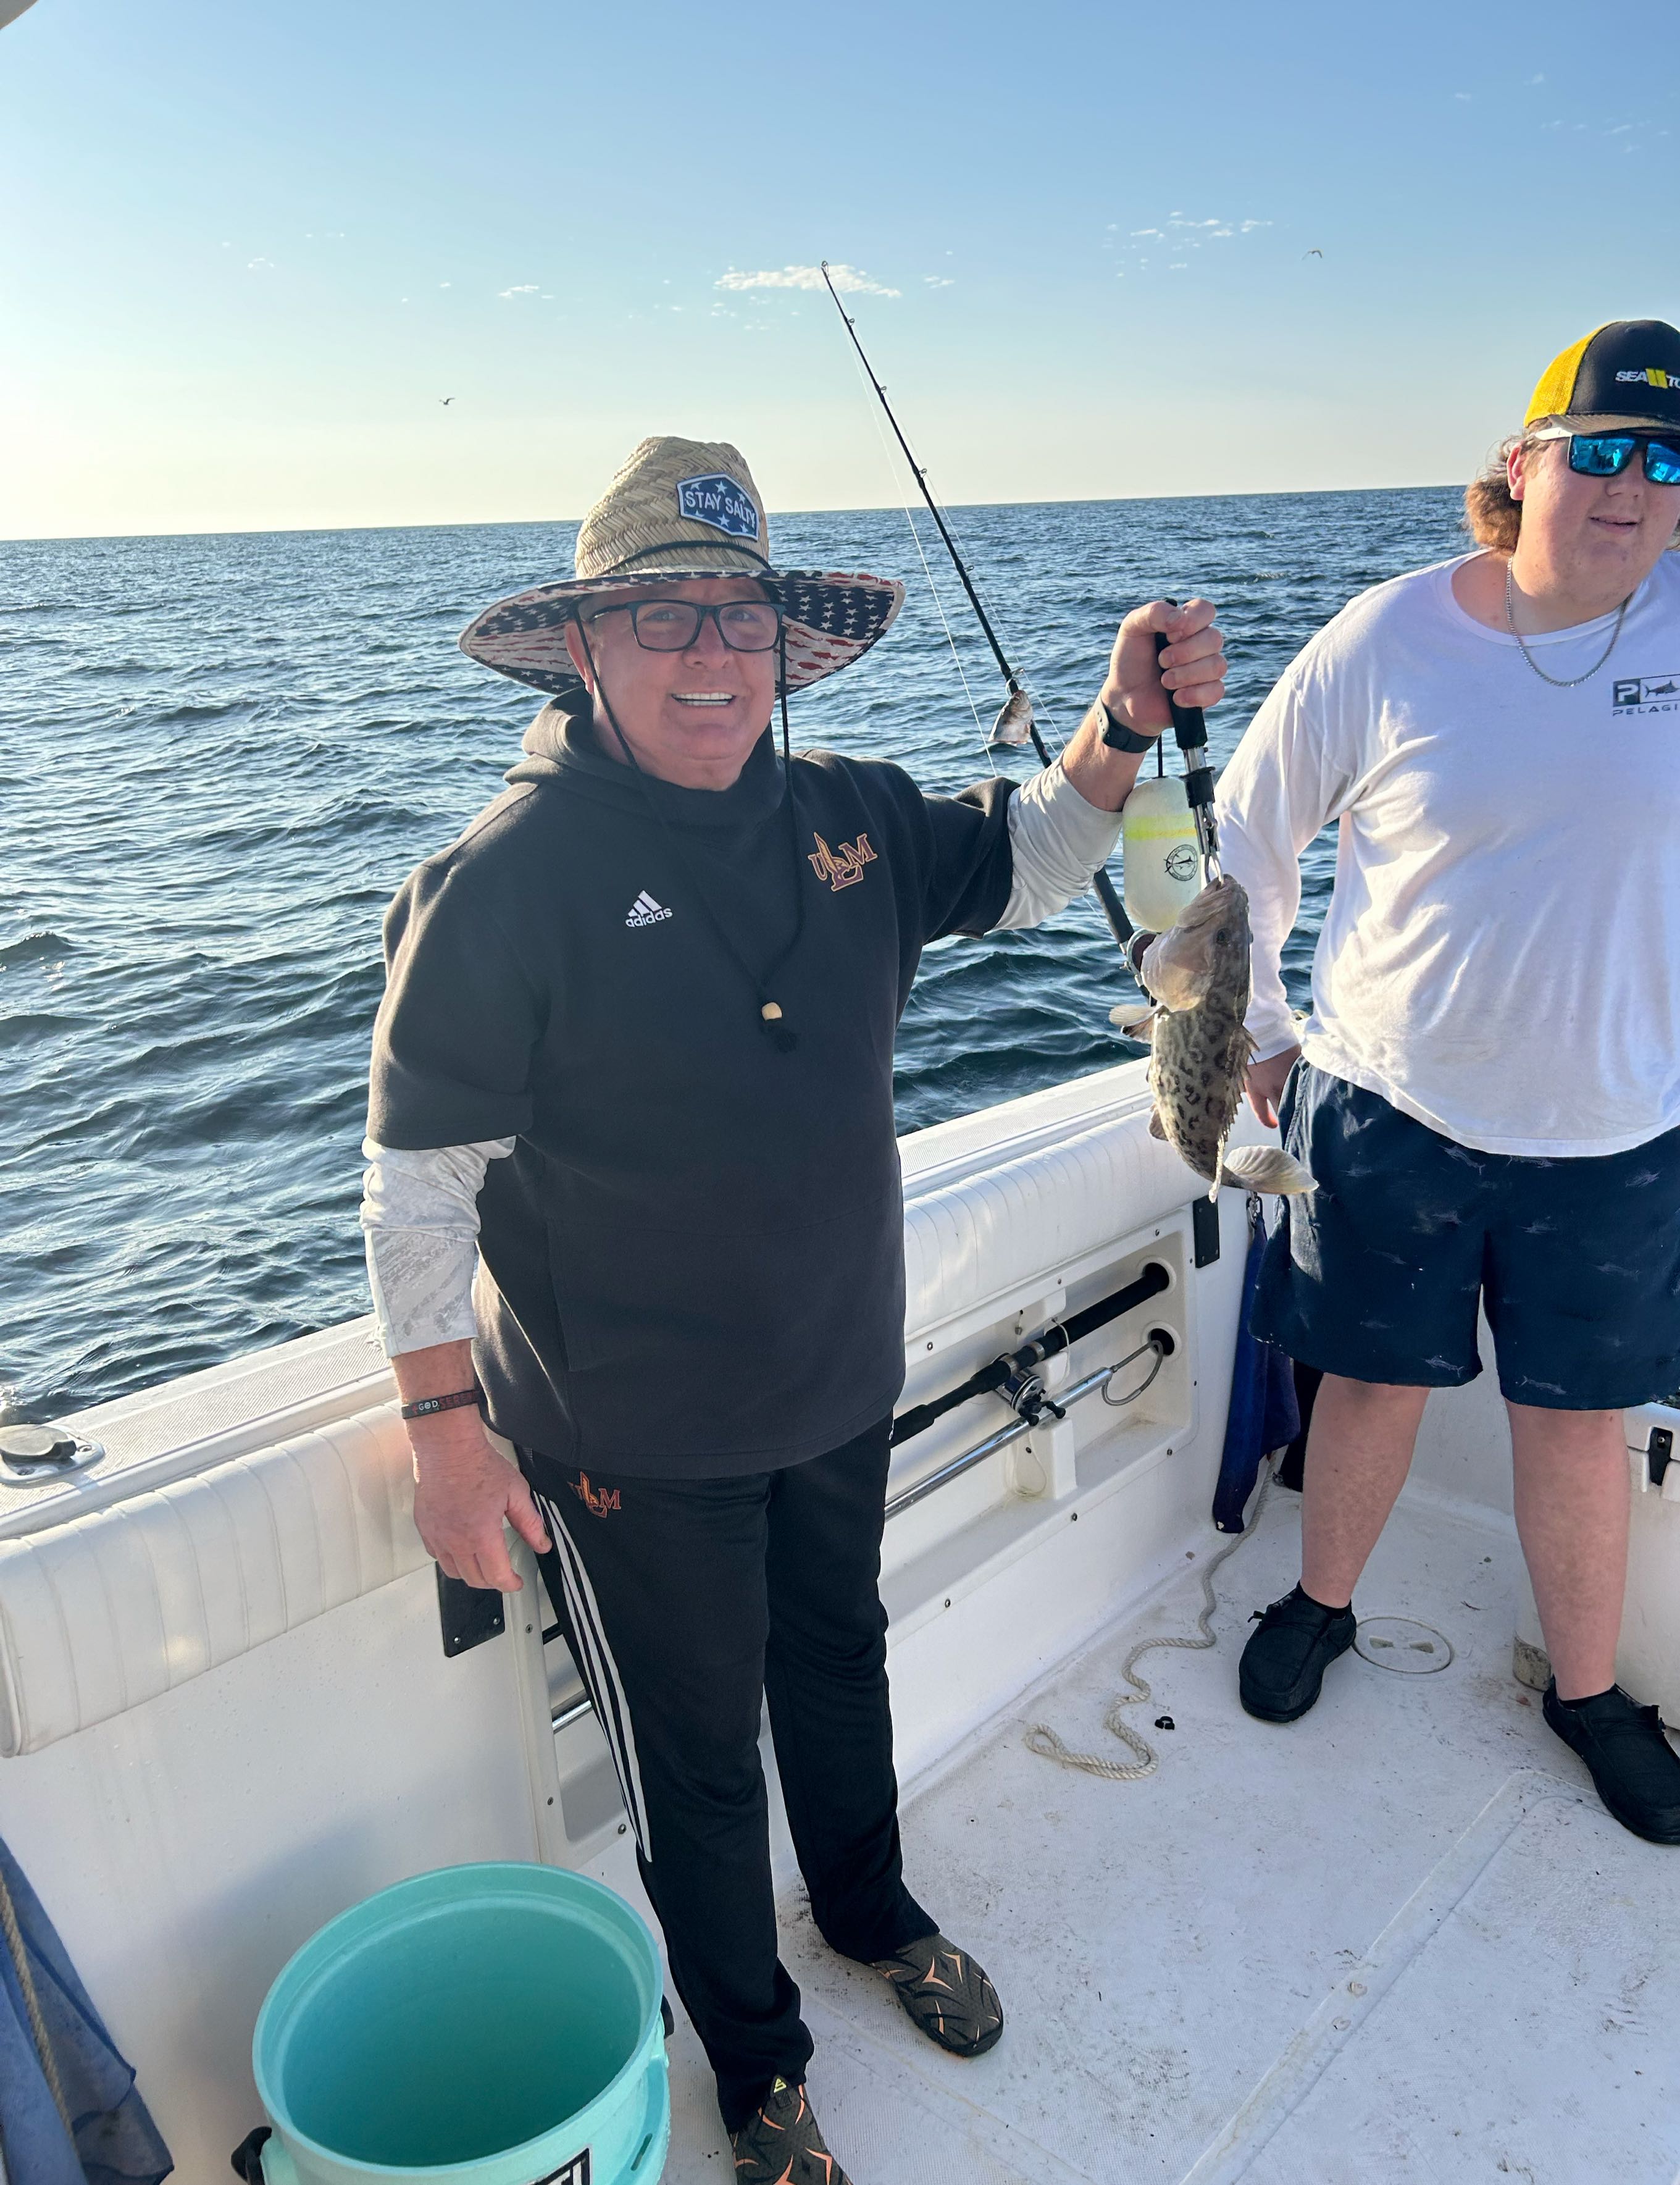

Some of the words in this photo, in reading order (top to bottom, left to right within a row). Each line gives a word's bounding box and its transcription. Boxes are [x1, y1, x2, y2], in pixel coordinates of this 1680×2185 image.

[1615, 371, 1648, 382] SEA
[685, 490, 721, 511] STAY
[725, 497, 756, 529] SALTY
[625, 907, 673, 928] adidas
[418, 1400, 438, 1411] GOD
